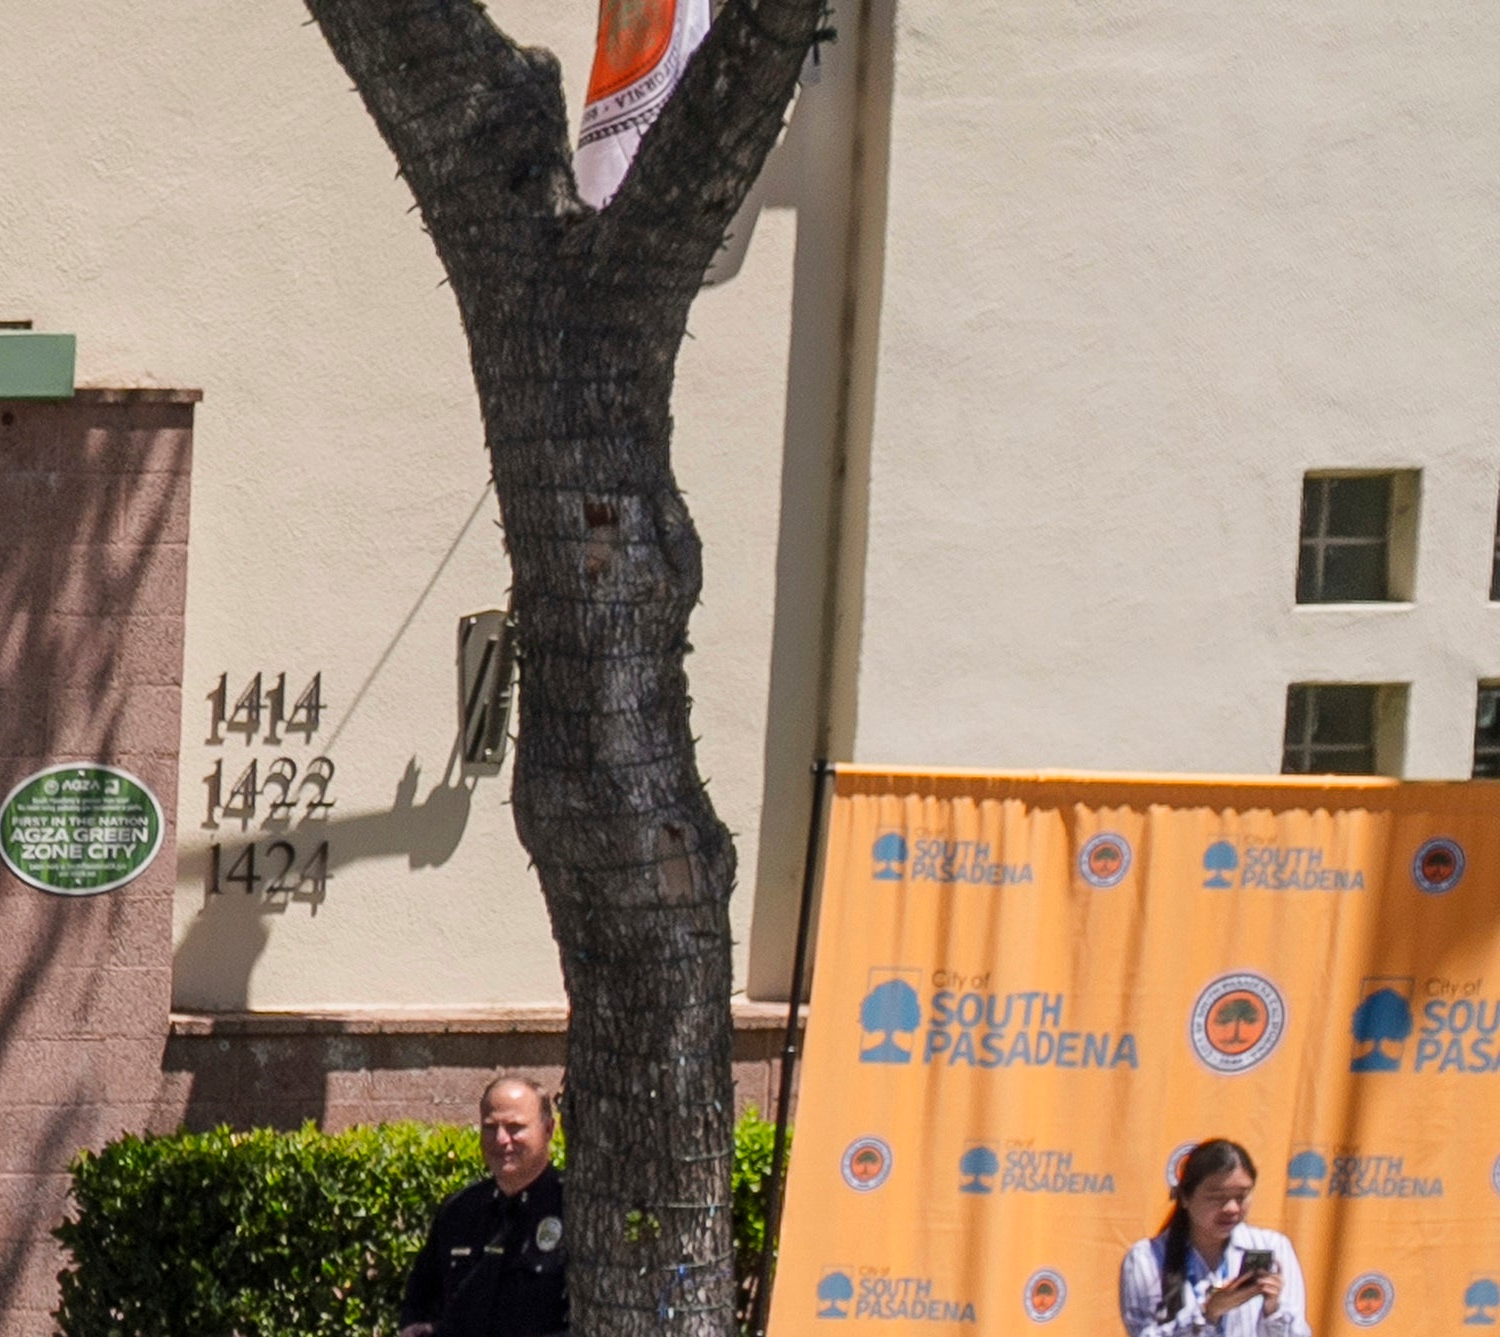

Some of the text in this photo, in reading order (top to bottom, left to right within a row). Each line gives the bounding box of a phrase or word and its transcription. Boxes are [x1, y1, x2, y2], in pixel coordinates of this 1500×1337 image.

[214, 671, 328, 732] 1414
[212, 756, 338, 812] 1422
[11, 816, 149, 827] FIRST IN THE NATION
[9, 827, 149, 843] AGZA GREEN
[20, 844, 138, 860] ZONE CITY
[912, 838, 991, 861] SOUTH
[1244, 846, 1324, 868] SOUTH
[208, 840, 336, 896] 1424
[911, 862, 1034, 885] PASADENA
[1239, 868, 1365, 891] PASADENA
[931, 969, 991, 990] City of
[929, 990, 1064, 1029] SOUTH
[1421, 999, 1500, 1034] SOU
[922, 1029, 1140, 1069] PASADENA
[1005, 1150, 1074, 1171] SOUTH
[1332, 1155, 1404, 1176] SOUTH
[1001, 1170, 1116, 1193] PASADENA
[1328, 1174, 1444, 1197] PASADENA
[859, 1277, 932, 1299] SOUTH
[856, 1298, 976, 1323] PASADENA
